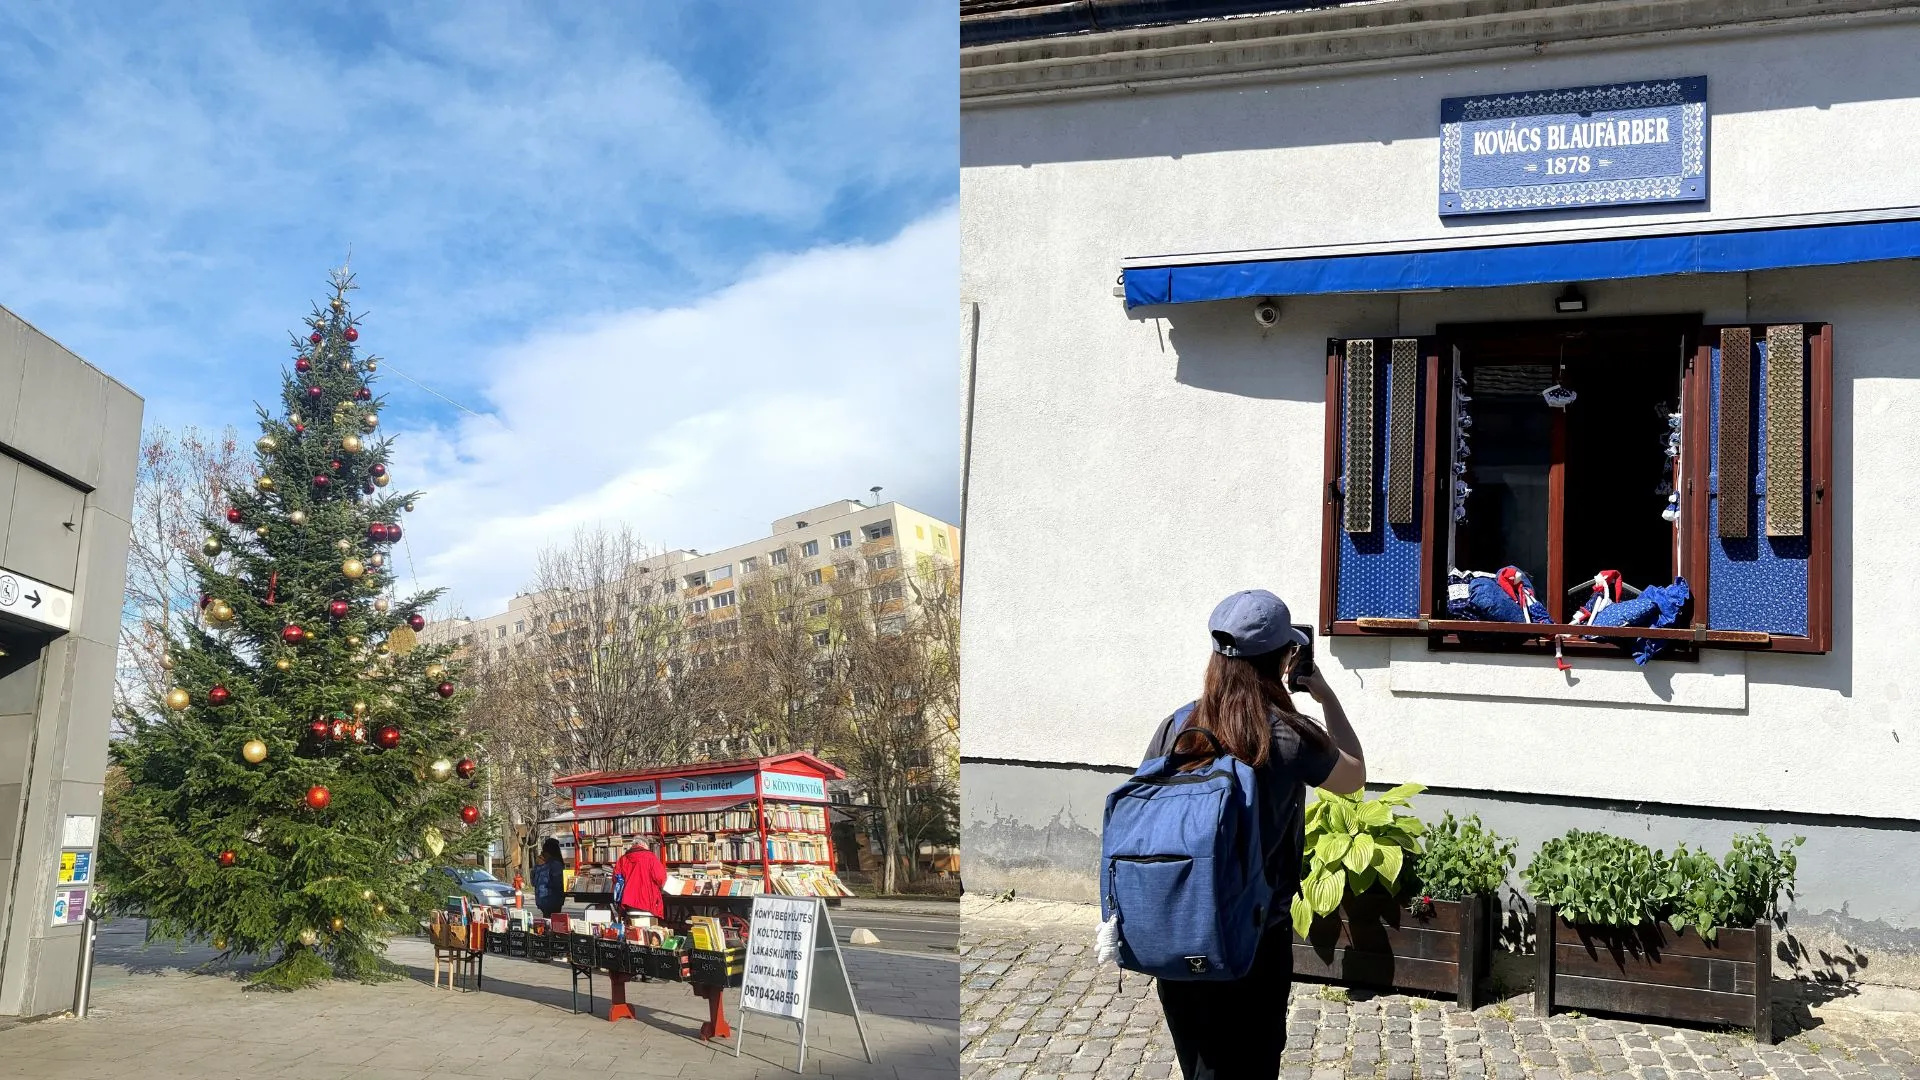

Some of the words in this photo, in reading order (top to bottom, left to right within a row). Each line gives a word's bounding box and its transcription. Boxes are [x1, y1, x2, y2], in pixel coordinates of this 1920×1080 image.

[1473, 121, 1541, 156] KOVÁCS
[1547, 117, 1670, 152] BLAUFÄRBER
[1544, 155, 1591, 176] 1878
[624, 785, 655, 797] könyvek
[680, 781, 694, 793] 450
[696, 779, 733, 792] Forintért
[744, 984, 800, 1005] 06704248550
